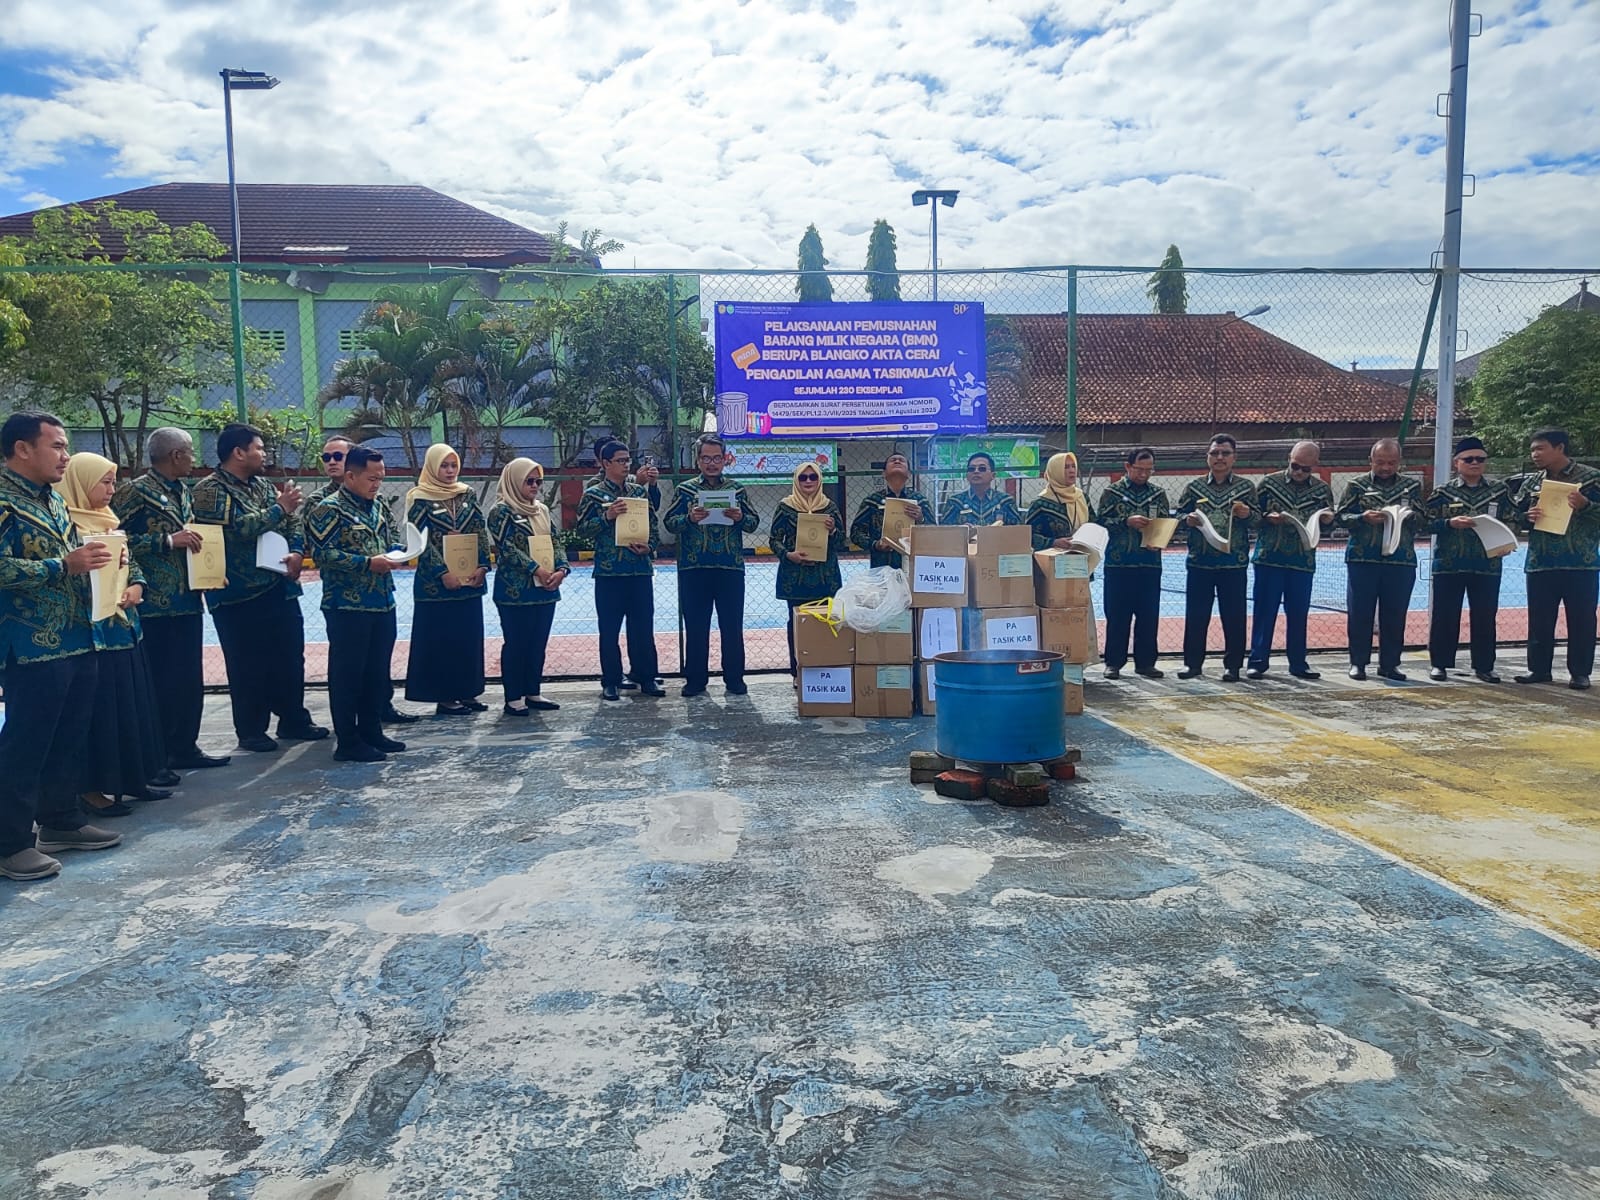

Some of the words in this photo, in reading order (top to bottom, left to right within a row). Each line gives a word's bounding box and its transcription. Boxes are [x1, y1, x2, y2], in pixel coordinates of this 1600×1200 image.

[764, 320, 851, 332] PELAKSANAAN
[854, 320, 937, 331] PEMUSNAHAN
[763, 335, 814, 346] BARANG
[816, 335, 848, 346] MILIK
[850, 334, 900, 346] NEGARA
[902, 333, 939, 347] (BMN)
[762, 349, 809, 361] BERUPA
[811, 349, 869, 361] BLANGKO
[871, 349, 903, 360] AKTA
[905, 349, 940, 360] CERAI
[746, 368, 823, 380] PENGADILAN
[825, 368, 871, 379] AGAMA
[873, 365, 957, 379] TASIKMALAYA
[793, 386, 838, 395] SEJUMLAH
[856, 386, 903, 395] EKSEMPLAR
[934, 561, 946, 569] PA
[919, 574, 942, 582] TASIK
[943, 575, 960, 583] KAB
[1006, 622, 1017, 630] PA
[992, 636, 1015, 644] TASIK
[807, 685, 829, 693] TASIK
